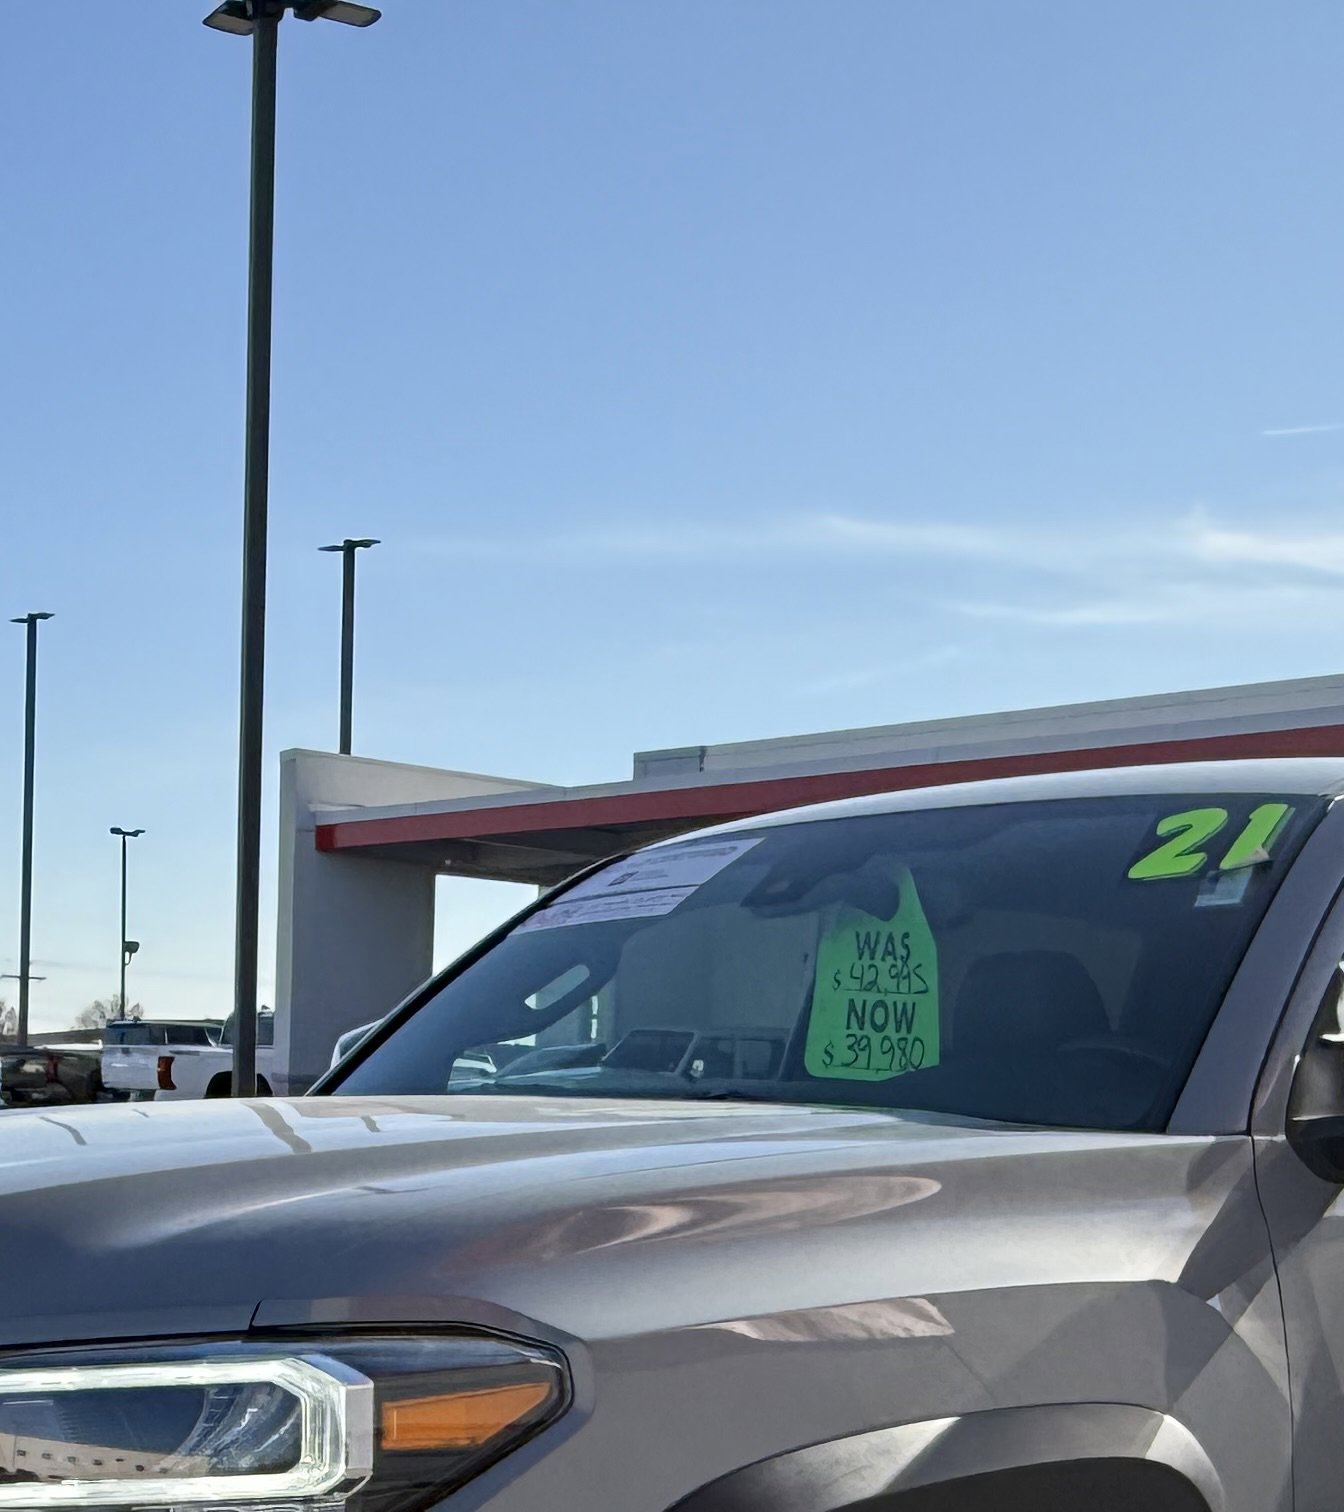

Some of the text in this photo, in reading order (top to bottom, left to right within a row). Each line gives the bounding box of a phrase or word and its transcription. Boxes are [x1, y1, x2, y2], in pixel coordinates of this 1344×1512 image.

[1128, 803, 1289, 880] 21
[855, 930, 911, 964] WAS
[845, 998, 916, 1036] NOW
